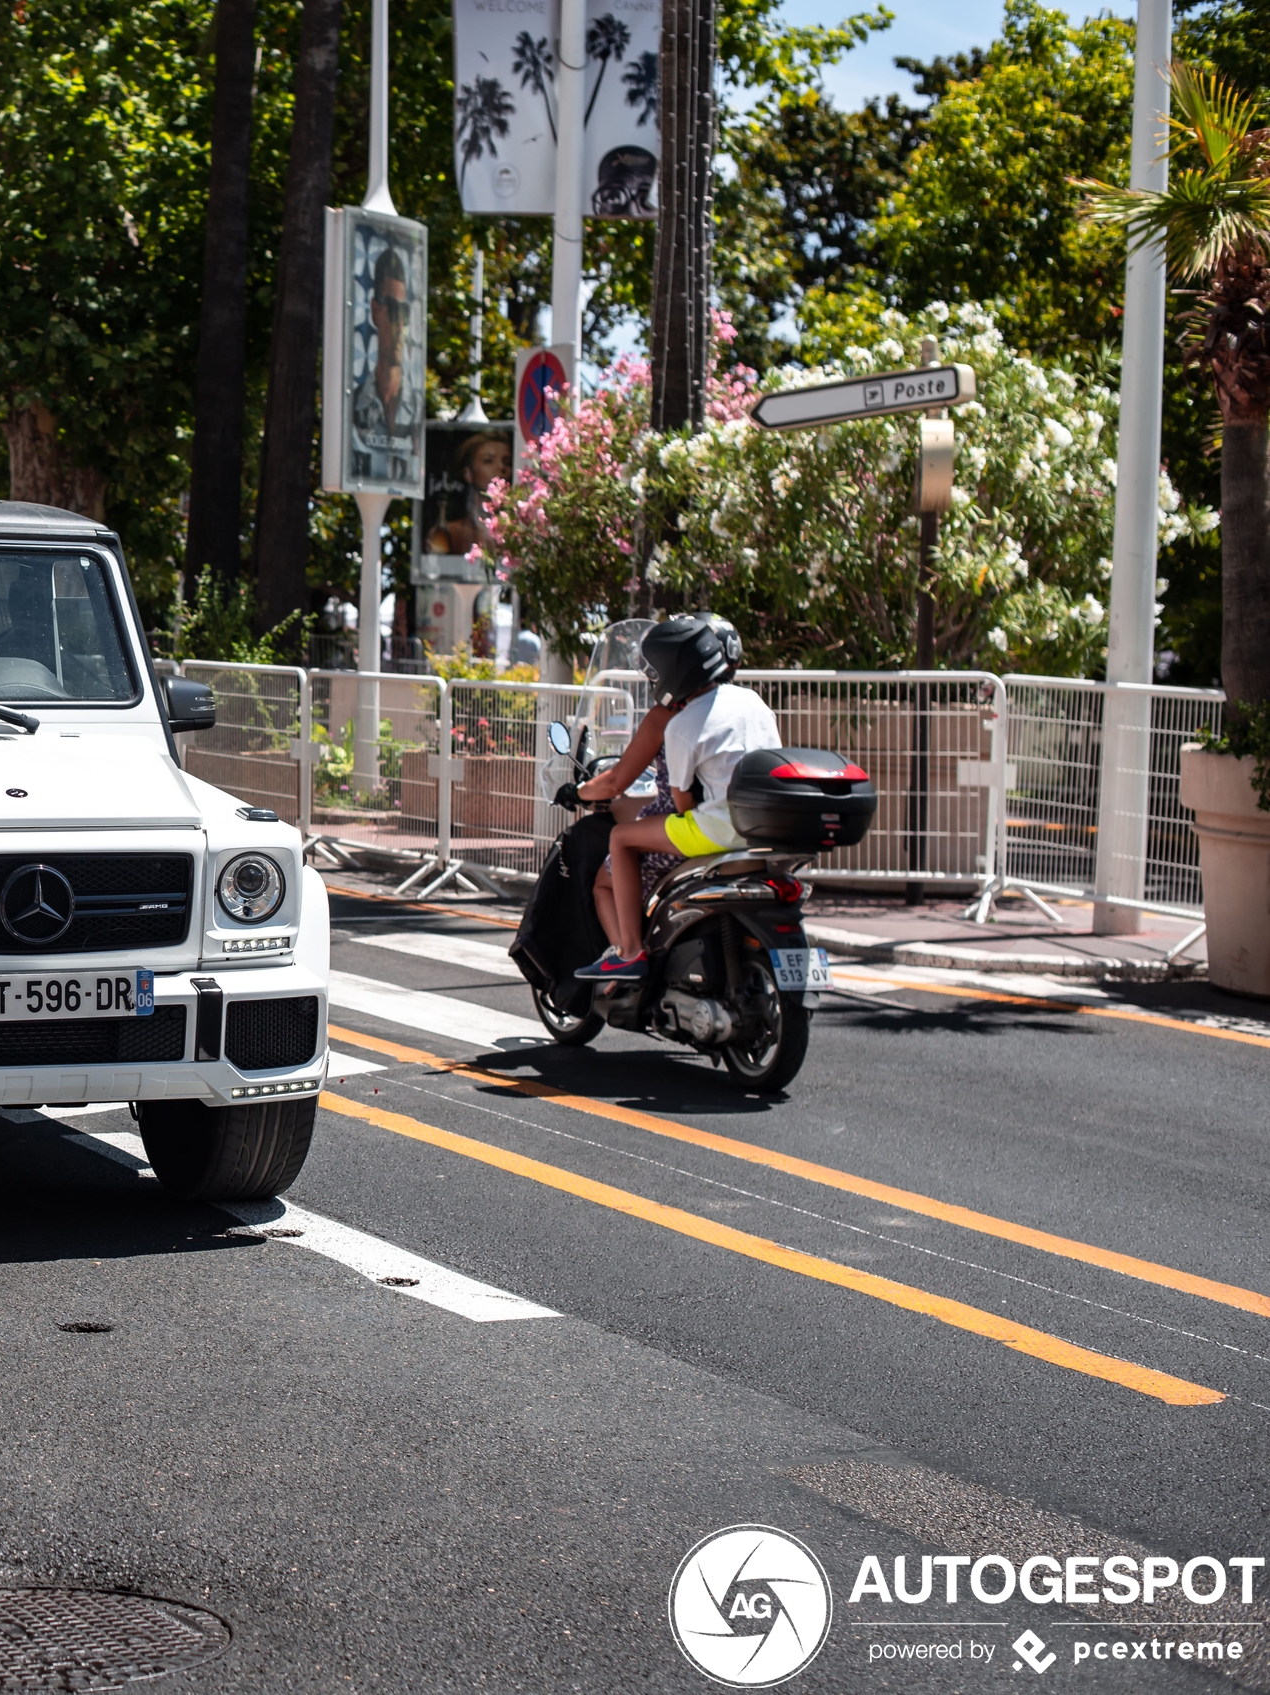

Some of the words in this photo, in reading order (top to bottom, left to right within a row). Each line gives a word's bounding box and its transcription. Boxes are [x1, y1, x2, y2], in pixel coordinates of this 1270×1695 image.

[473, 0, 546, 14] WELCOME
[894, 379, 946, 401] Poste
[780, 969, 827, 982] 513-QV
[137, 992, 153, 1008] 06
